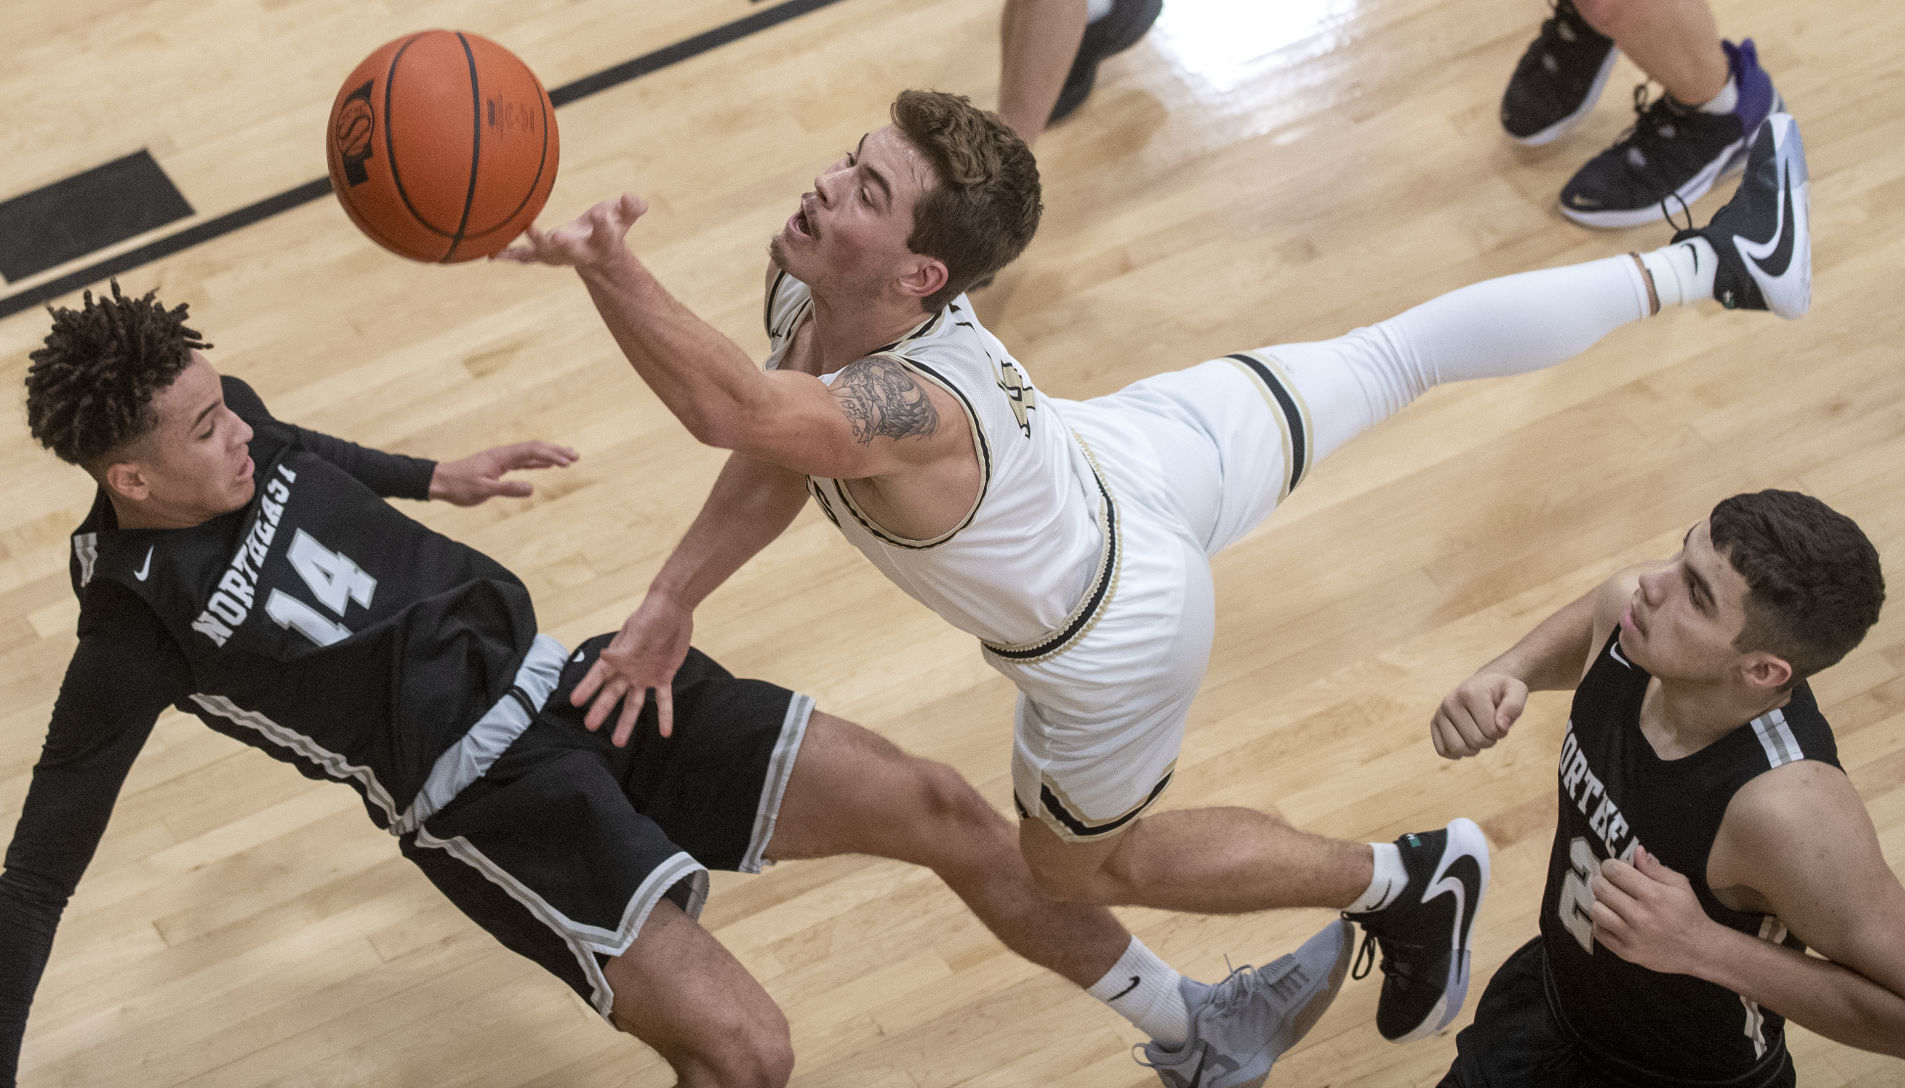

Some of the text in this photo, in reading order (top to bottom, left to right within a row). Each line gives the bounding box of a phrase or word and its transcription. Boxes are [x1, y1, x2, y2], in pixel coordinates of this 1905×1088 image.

[191, 463, 297, 648] NORTHEAST
[264, 527, 378, 648] 14
[1558, 717, 1640, 867] ORTHEA
